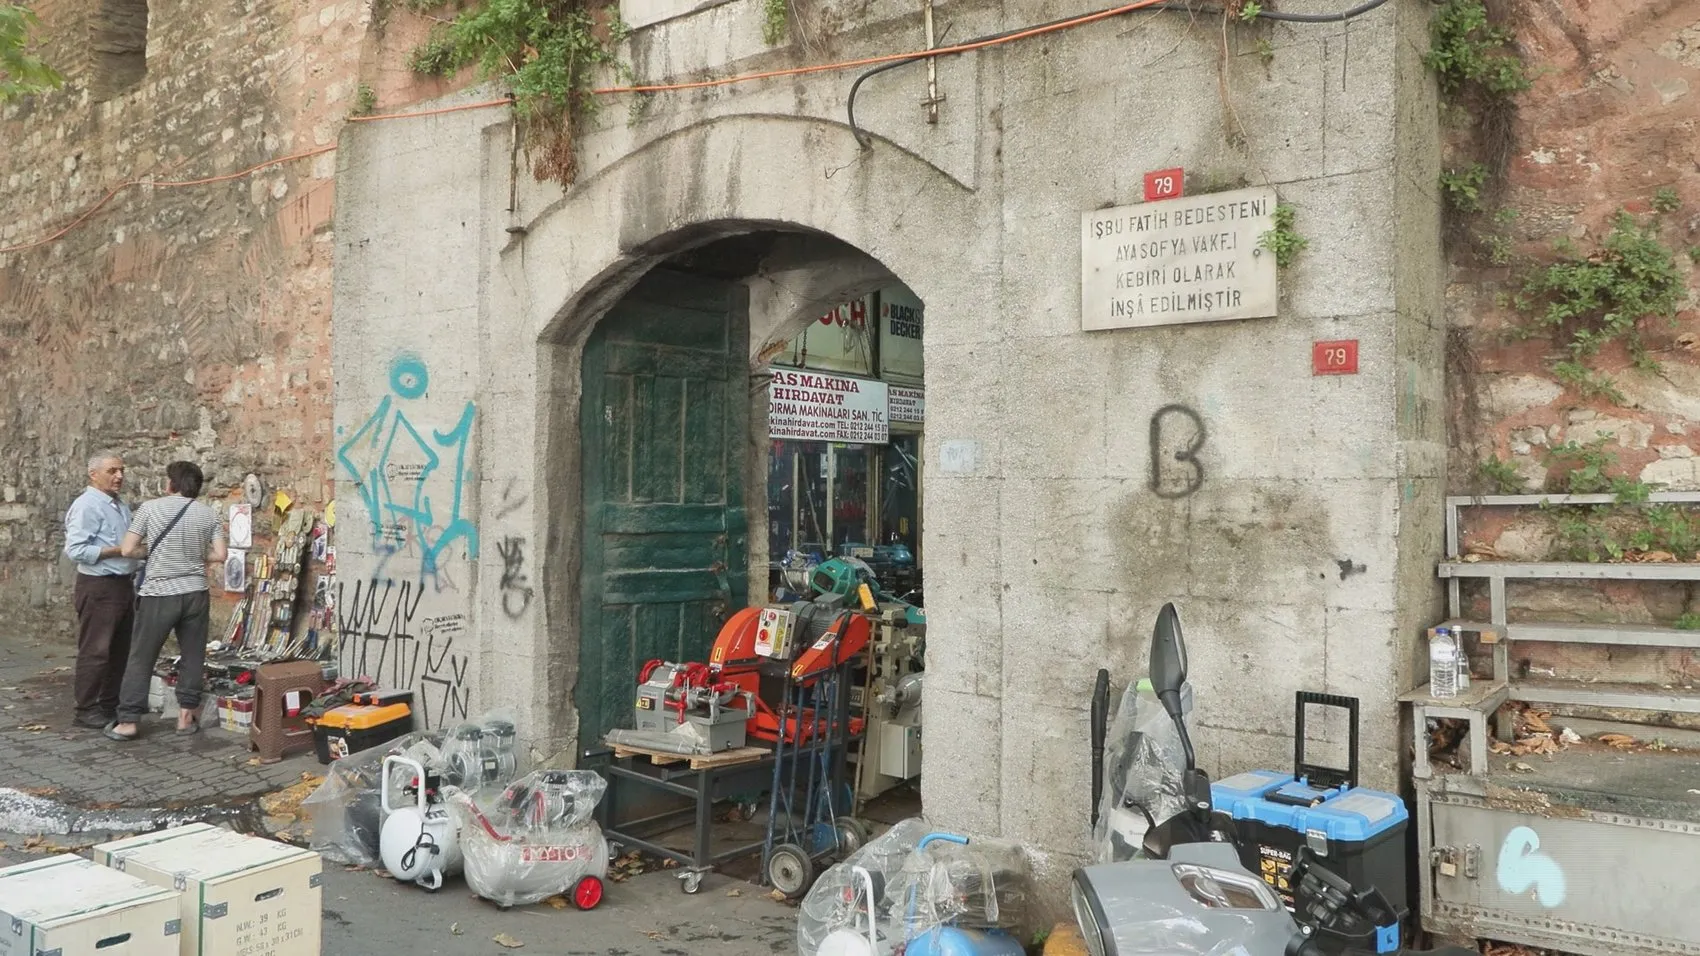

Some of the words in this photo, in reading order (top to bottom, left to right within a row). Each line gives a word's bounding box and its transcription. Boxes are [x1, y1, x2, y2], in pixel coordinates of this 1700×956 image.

[1154, 176, 1173, 195] 79
[1090, 218, 1123, 239] İŞBU
[1129, 209, 1168, 232] FATİH
[1174, 195, 1266, 227] BEDESTENİ
[1116, 238, 1186, 262] AYASOFYA
[1173, 261, 1236, 284] OLARAK
[1111, 293, 1145, 318] İNŞÂ
[1150, 287, 1241, 313] EDİLMİŞTİR
[890, 320, 920, 340] DECKER
[1325, 348, 1346, 366] 79
[799, 374, 860, 393] MAKINA
[773, 387, 845, 405] HIRDAVAT
[799, 403, 850, 420] MAKİNALARI
[852, 409, 870, 422] SAN.
[871, 407, 885, 423] TİC.
[836, 430, 850, 439] FAX:
[850, 431, 864, 440] 0212
[864, 432, 874, 440] 244
[837, 421, 850, 430] TEL:
[850, 421, 864, 431] 0212
[864, 423, 874, 432] 244
[874, 424, 881, 432] 15
